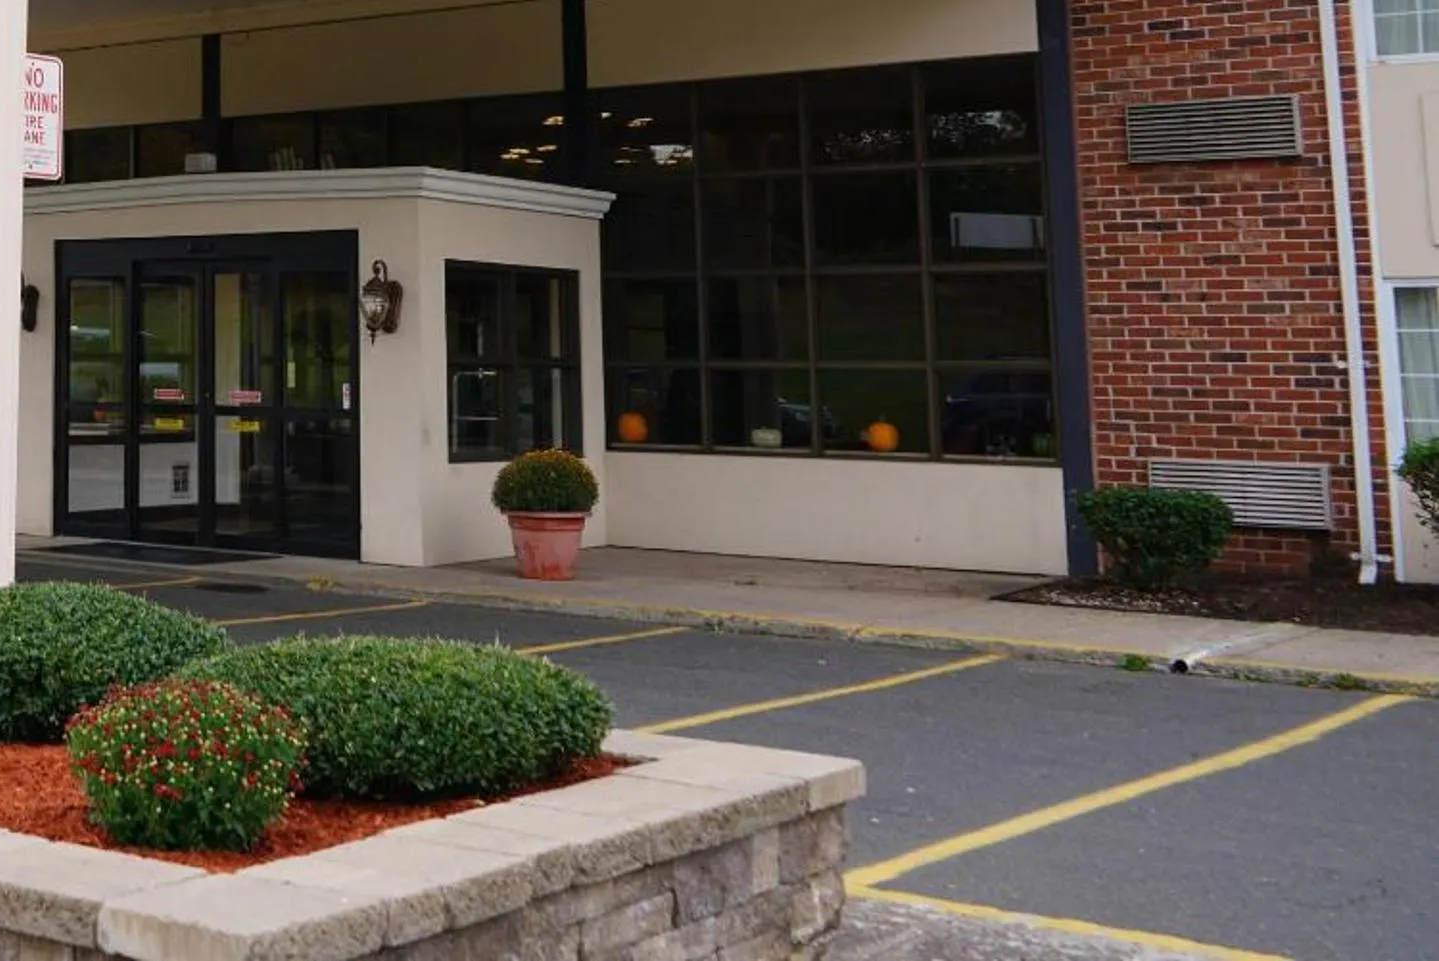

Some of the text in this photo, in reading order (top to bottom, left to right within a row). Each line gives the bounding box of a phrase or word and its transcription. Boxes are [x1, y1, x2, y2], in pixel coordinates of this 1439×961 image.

[24, 67, 45, 88] NO
[24, 91, 58, 114] RKING
[24, 115, 46, 129] IRE
[24, 131, 46, 145] ANE
